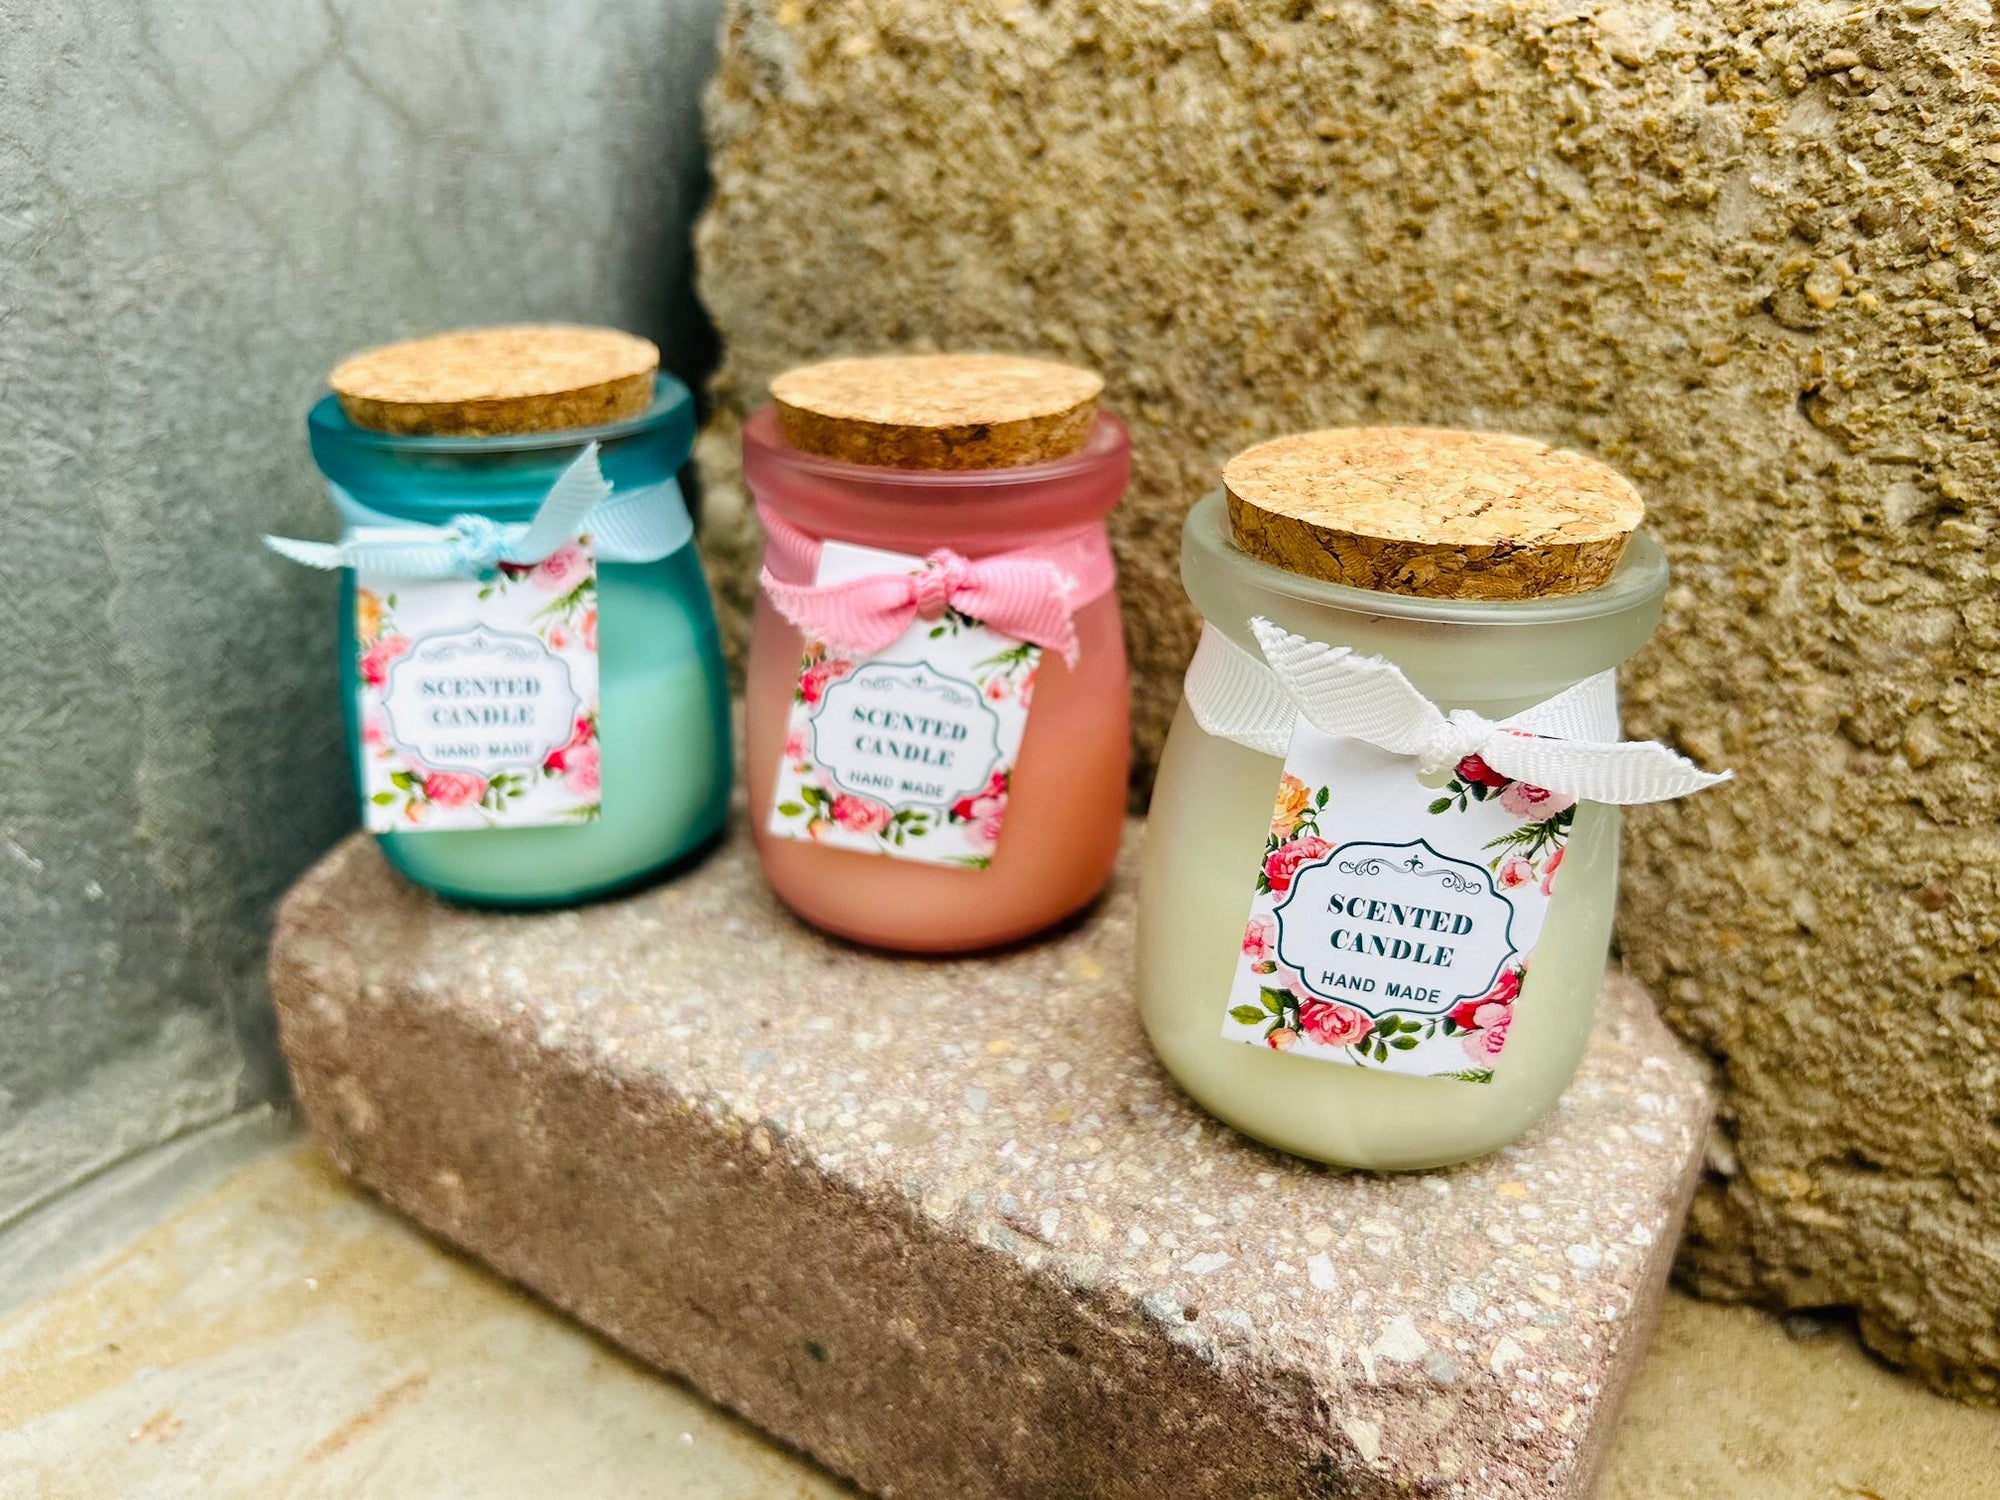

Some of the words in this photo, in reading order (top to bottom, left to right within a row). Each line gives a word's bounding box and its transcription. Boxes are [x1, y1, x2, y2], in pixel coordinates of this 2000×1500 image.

[421, 677, 541, 696] SCENTED
[431, 707, 534, 724] CANDLE
[853, 706, 968, 741] SCENTED
[434, 743, 480, 757] HAND
[488, 743, 531, 757] MADE
[855, 735, 955, 767] CANDLE
[850, 770, 894, 788] HAND
[900, 778, 945, 797] MADE
[1326, 893, 1473, 936] SCENTED
[1330, 928, 1455, 967] CANDLE
[1321, 970, 1376, 992] HAND
[1385, 982, 1441, 1004] MADE
